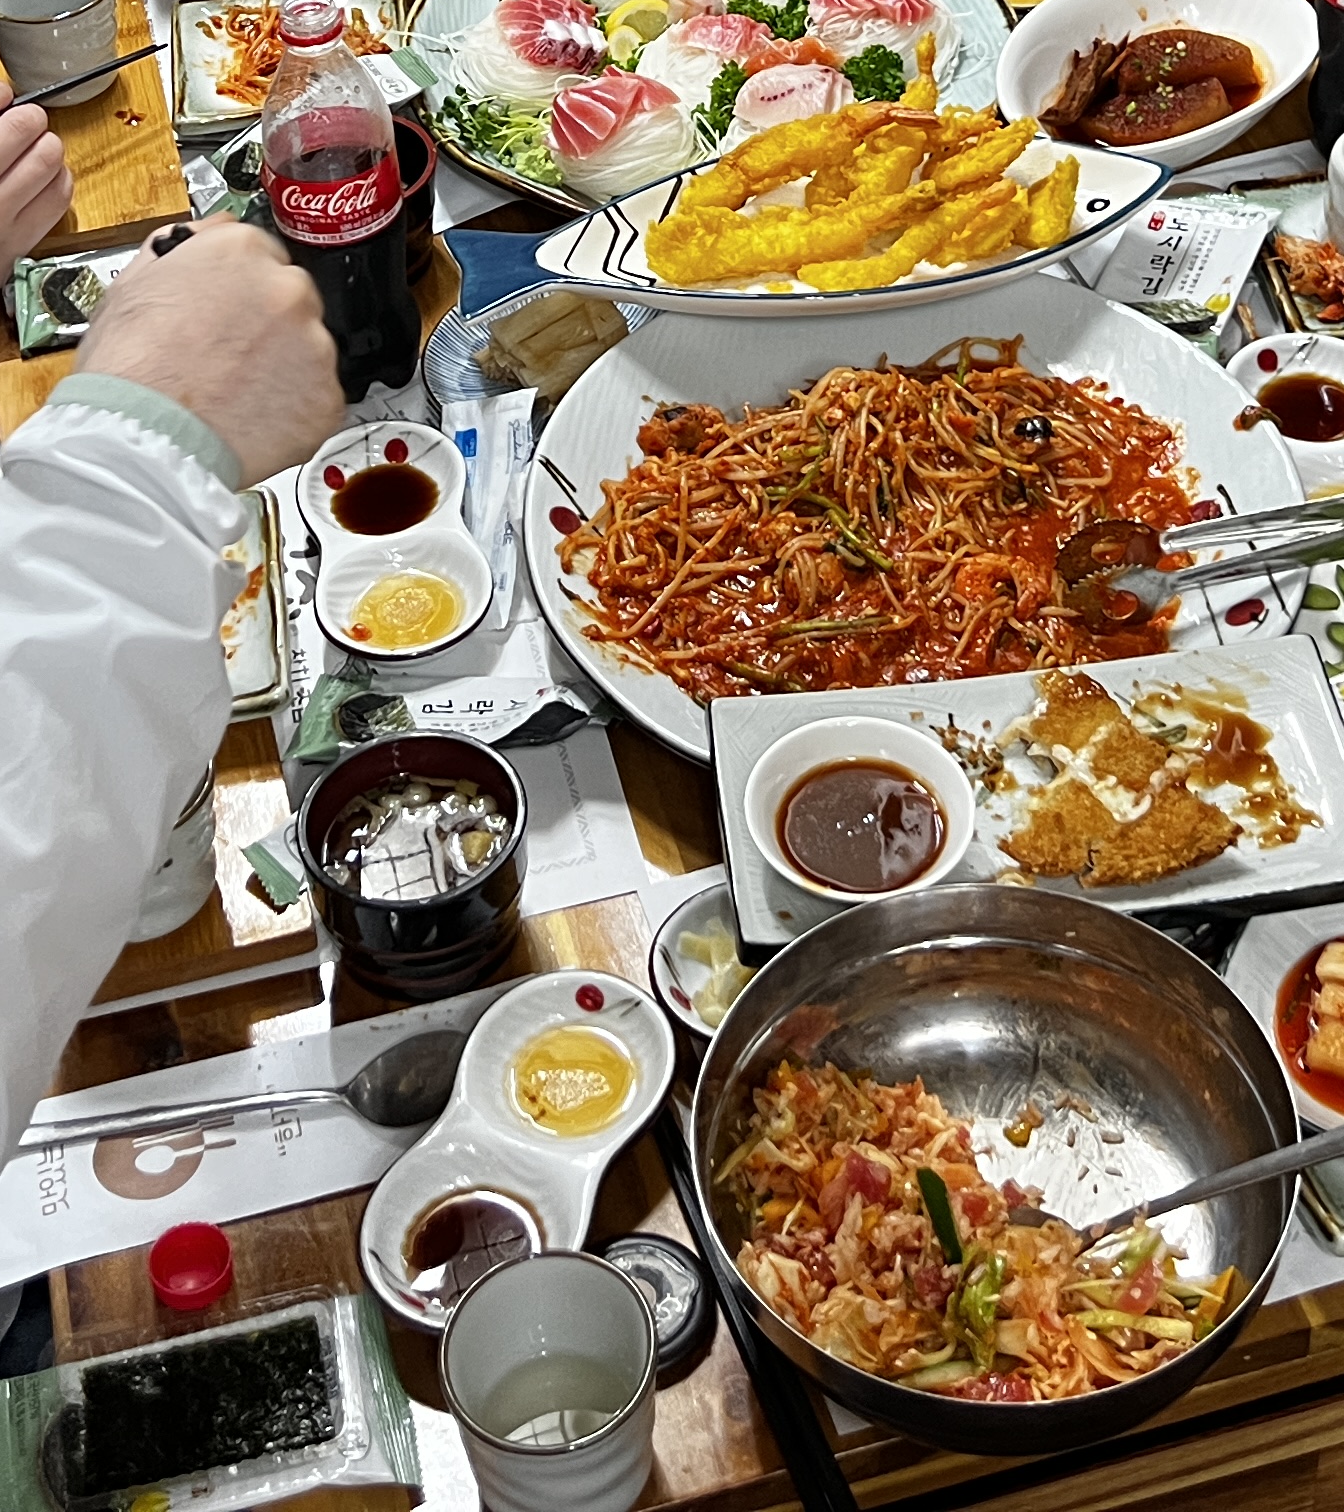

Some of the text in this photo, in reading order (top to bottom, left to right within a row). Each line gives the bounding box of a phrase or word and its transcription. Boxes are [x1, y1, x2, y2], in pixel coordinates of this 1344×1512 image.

[281, 171, 379, 217] Coca-Cola
[342, 207, 371, 221] TASTE
[421, 699, 528, 715] 시락김
